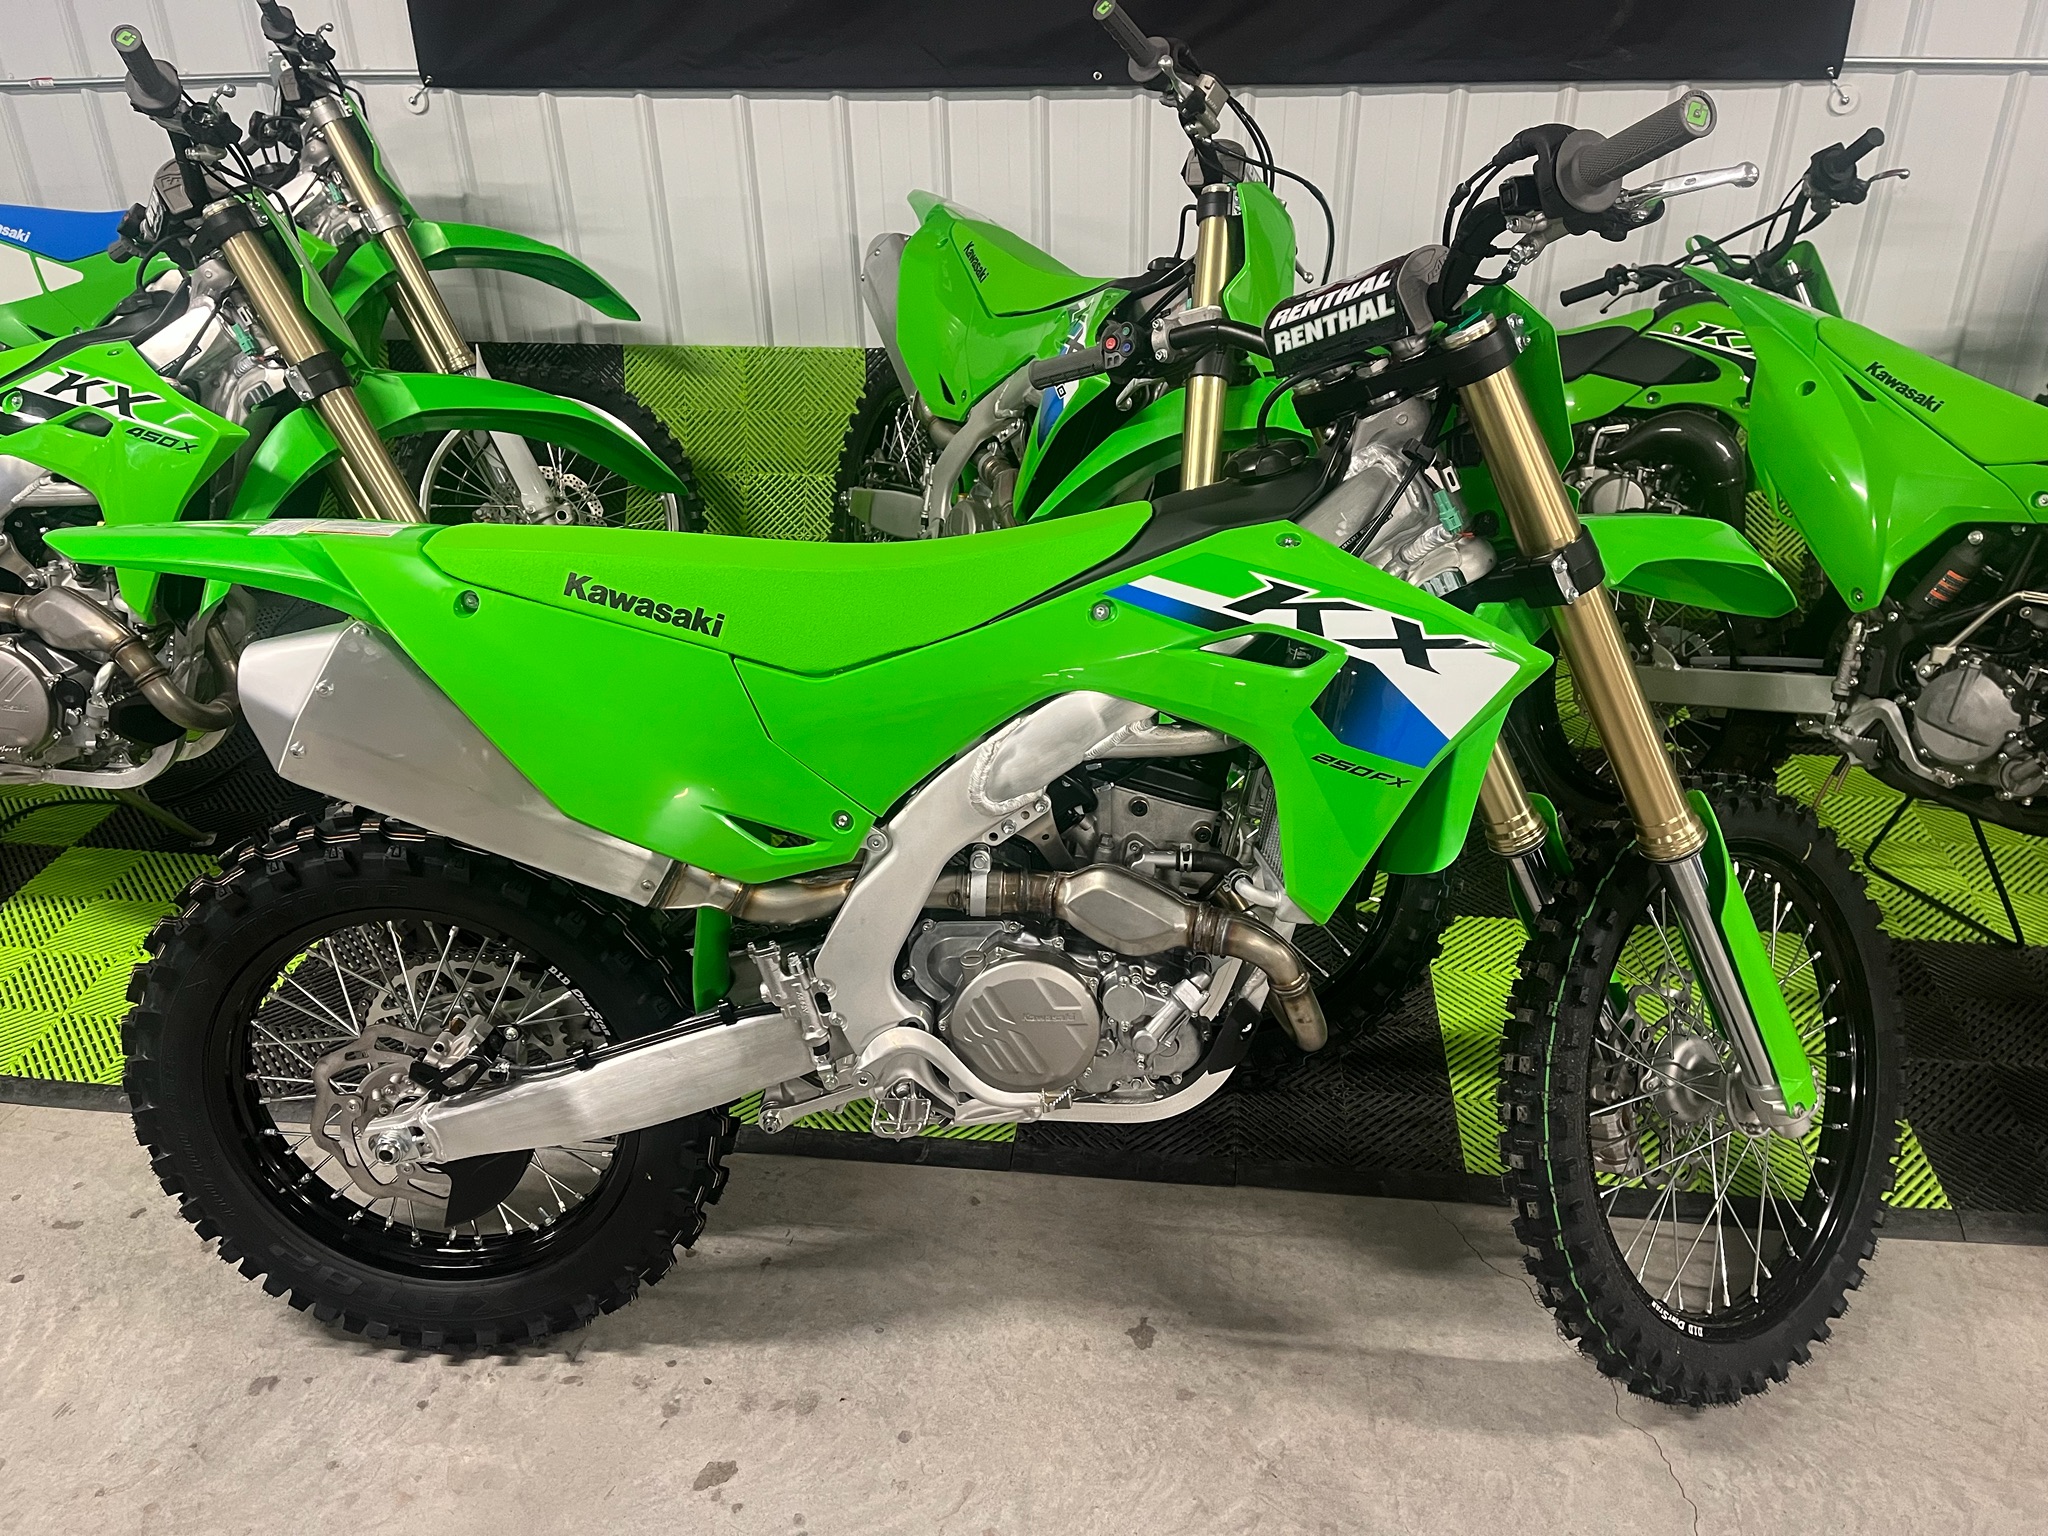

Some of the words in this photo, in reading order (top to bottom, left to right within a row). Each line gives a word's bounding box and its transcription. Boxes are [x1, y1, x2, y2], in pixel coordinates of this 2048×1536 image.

[963, 240, 990, 284] Kawasaki
[1268, 269, 1393, 330] RENTHAL
[1273, 293, 1396, 356] RENTHAL
[1685, 323, 1754, 354] K
[43, 369, 163, 422] KX
[1864, 360, 1946, 414] Kawasaki
[563, 571, 726, 638] Kawasaki
[1222, 578, 1492, 676] KX
[1310, 752, 1413, 789] 250FX
